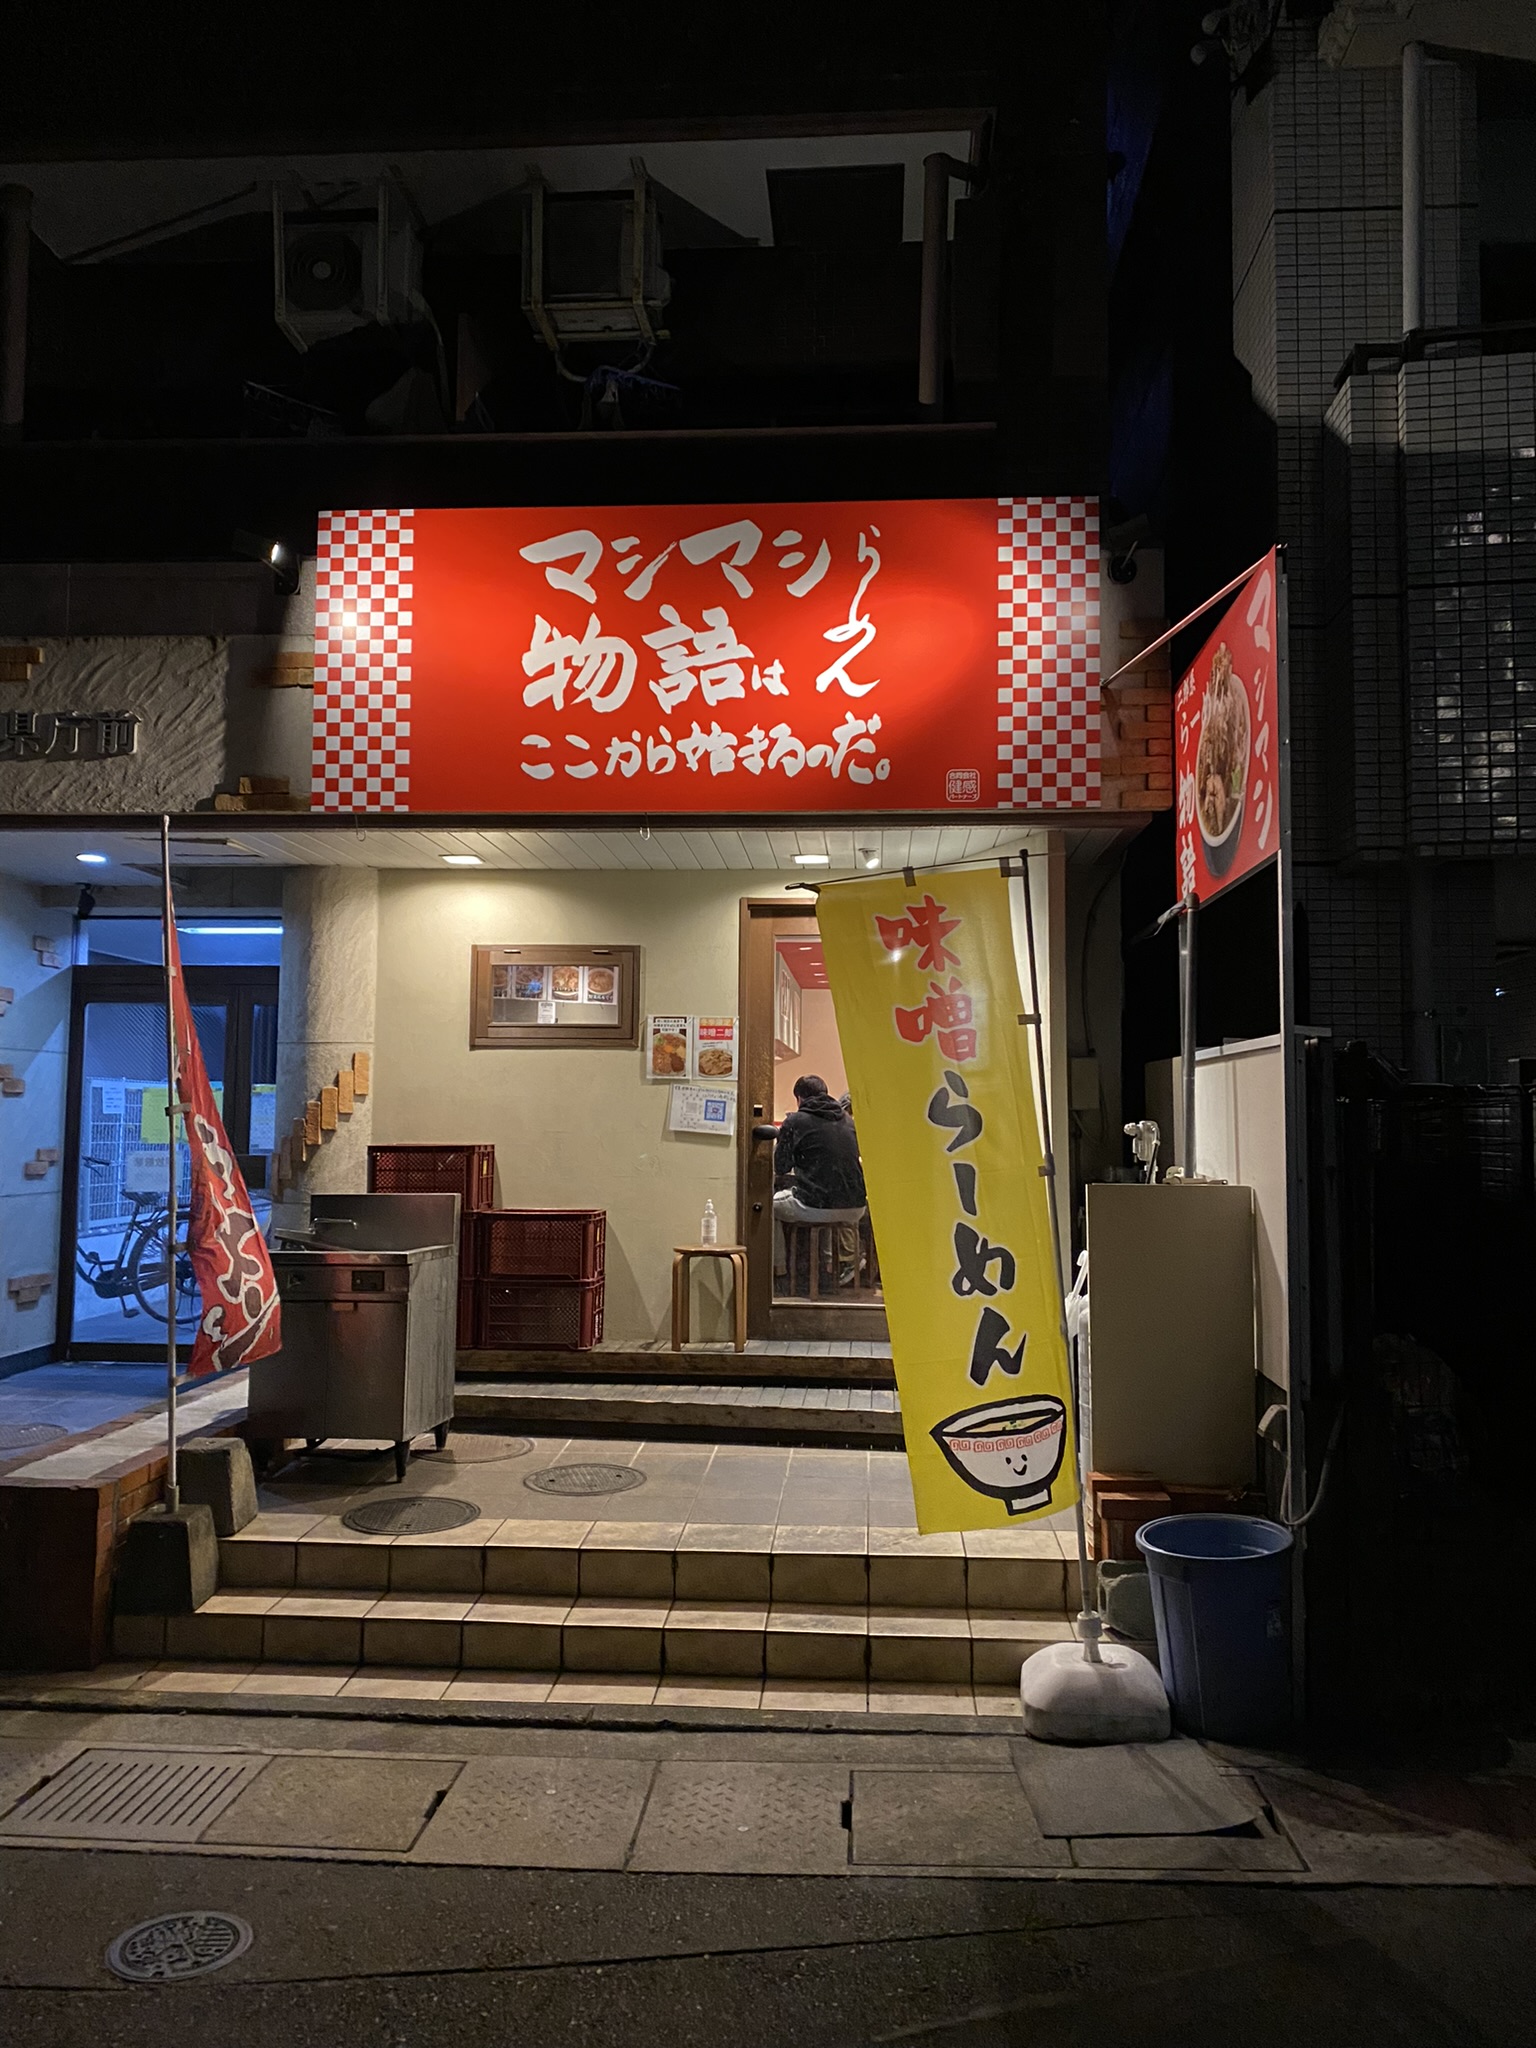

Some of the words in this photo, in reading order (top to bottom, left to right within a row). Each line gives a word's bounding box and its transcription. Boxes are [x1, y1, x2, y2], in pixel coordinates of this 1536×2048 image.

[519, 519, 831, 604] マシマシ
[521, 604, 790, 714] 物語は
[1246, 569, 1273, 850] マシマシ
[521, 711, 891, 784] ここから始まるのだ。
[1180, 760, 1196, 900] 物語
[874, 894, 1027, 1387] 味噌らーめん
